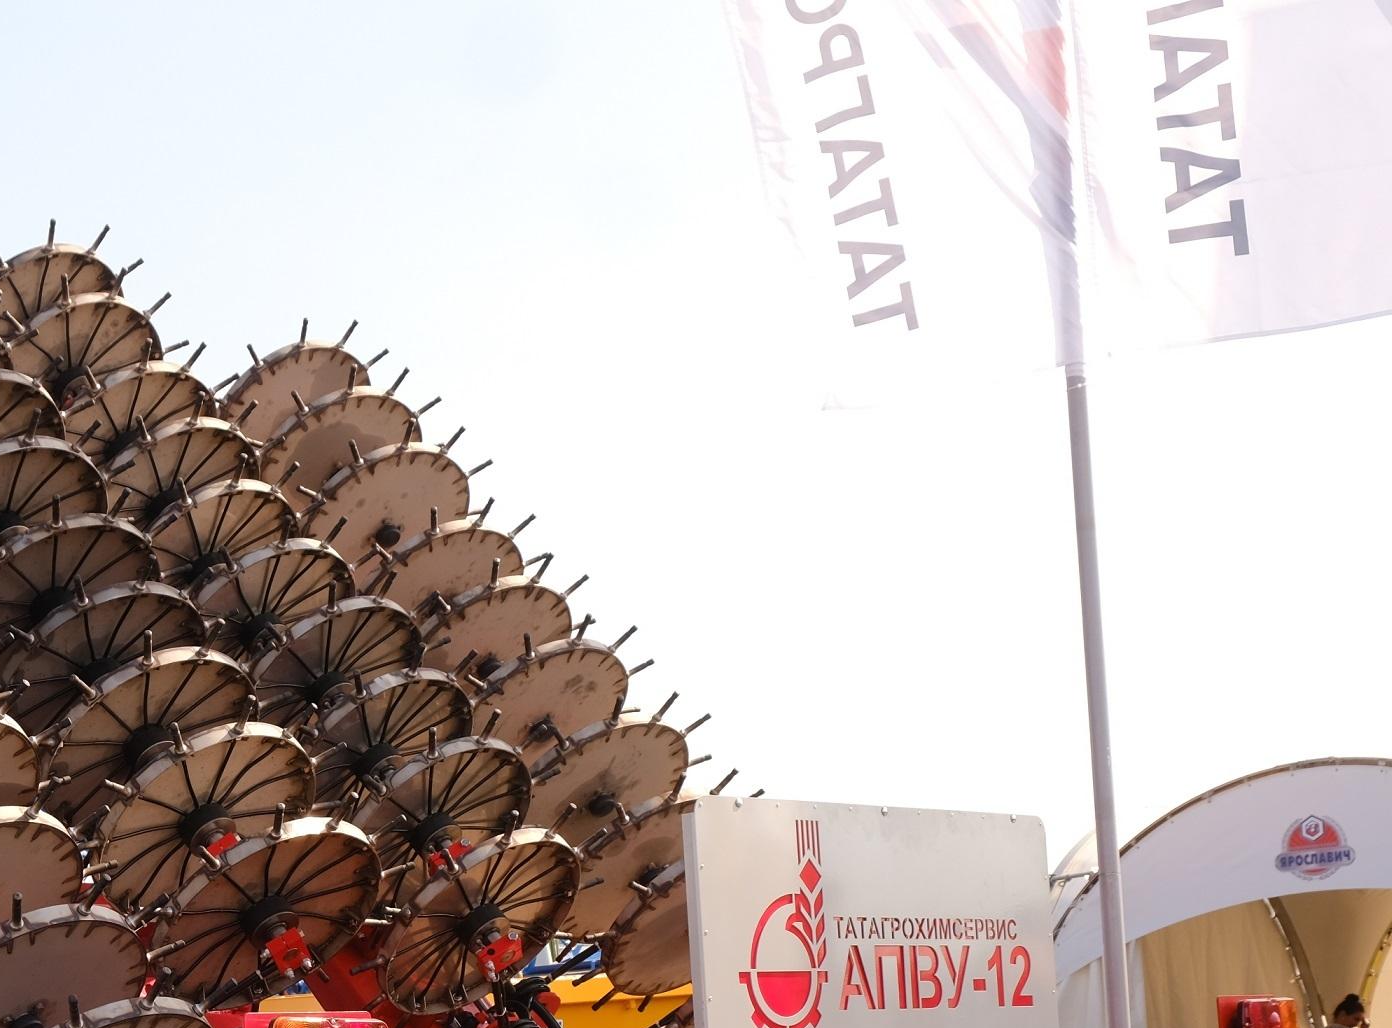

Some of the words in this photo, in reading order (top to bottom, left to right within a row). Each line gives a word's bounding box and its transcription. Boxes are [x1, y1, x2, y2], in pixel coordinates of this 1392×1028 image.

[1279, 850, 1351, 868] ЯРОСЛАВИЧ
[833, 916, 1018, 942] ТАТАГРОХИМСЕРВИС
[839, 944, 1034, 1011] АПВУ-12
